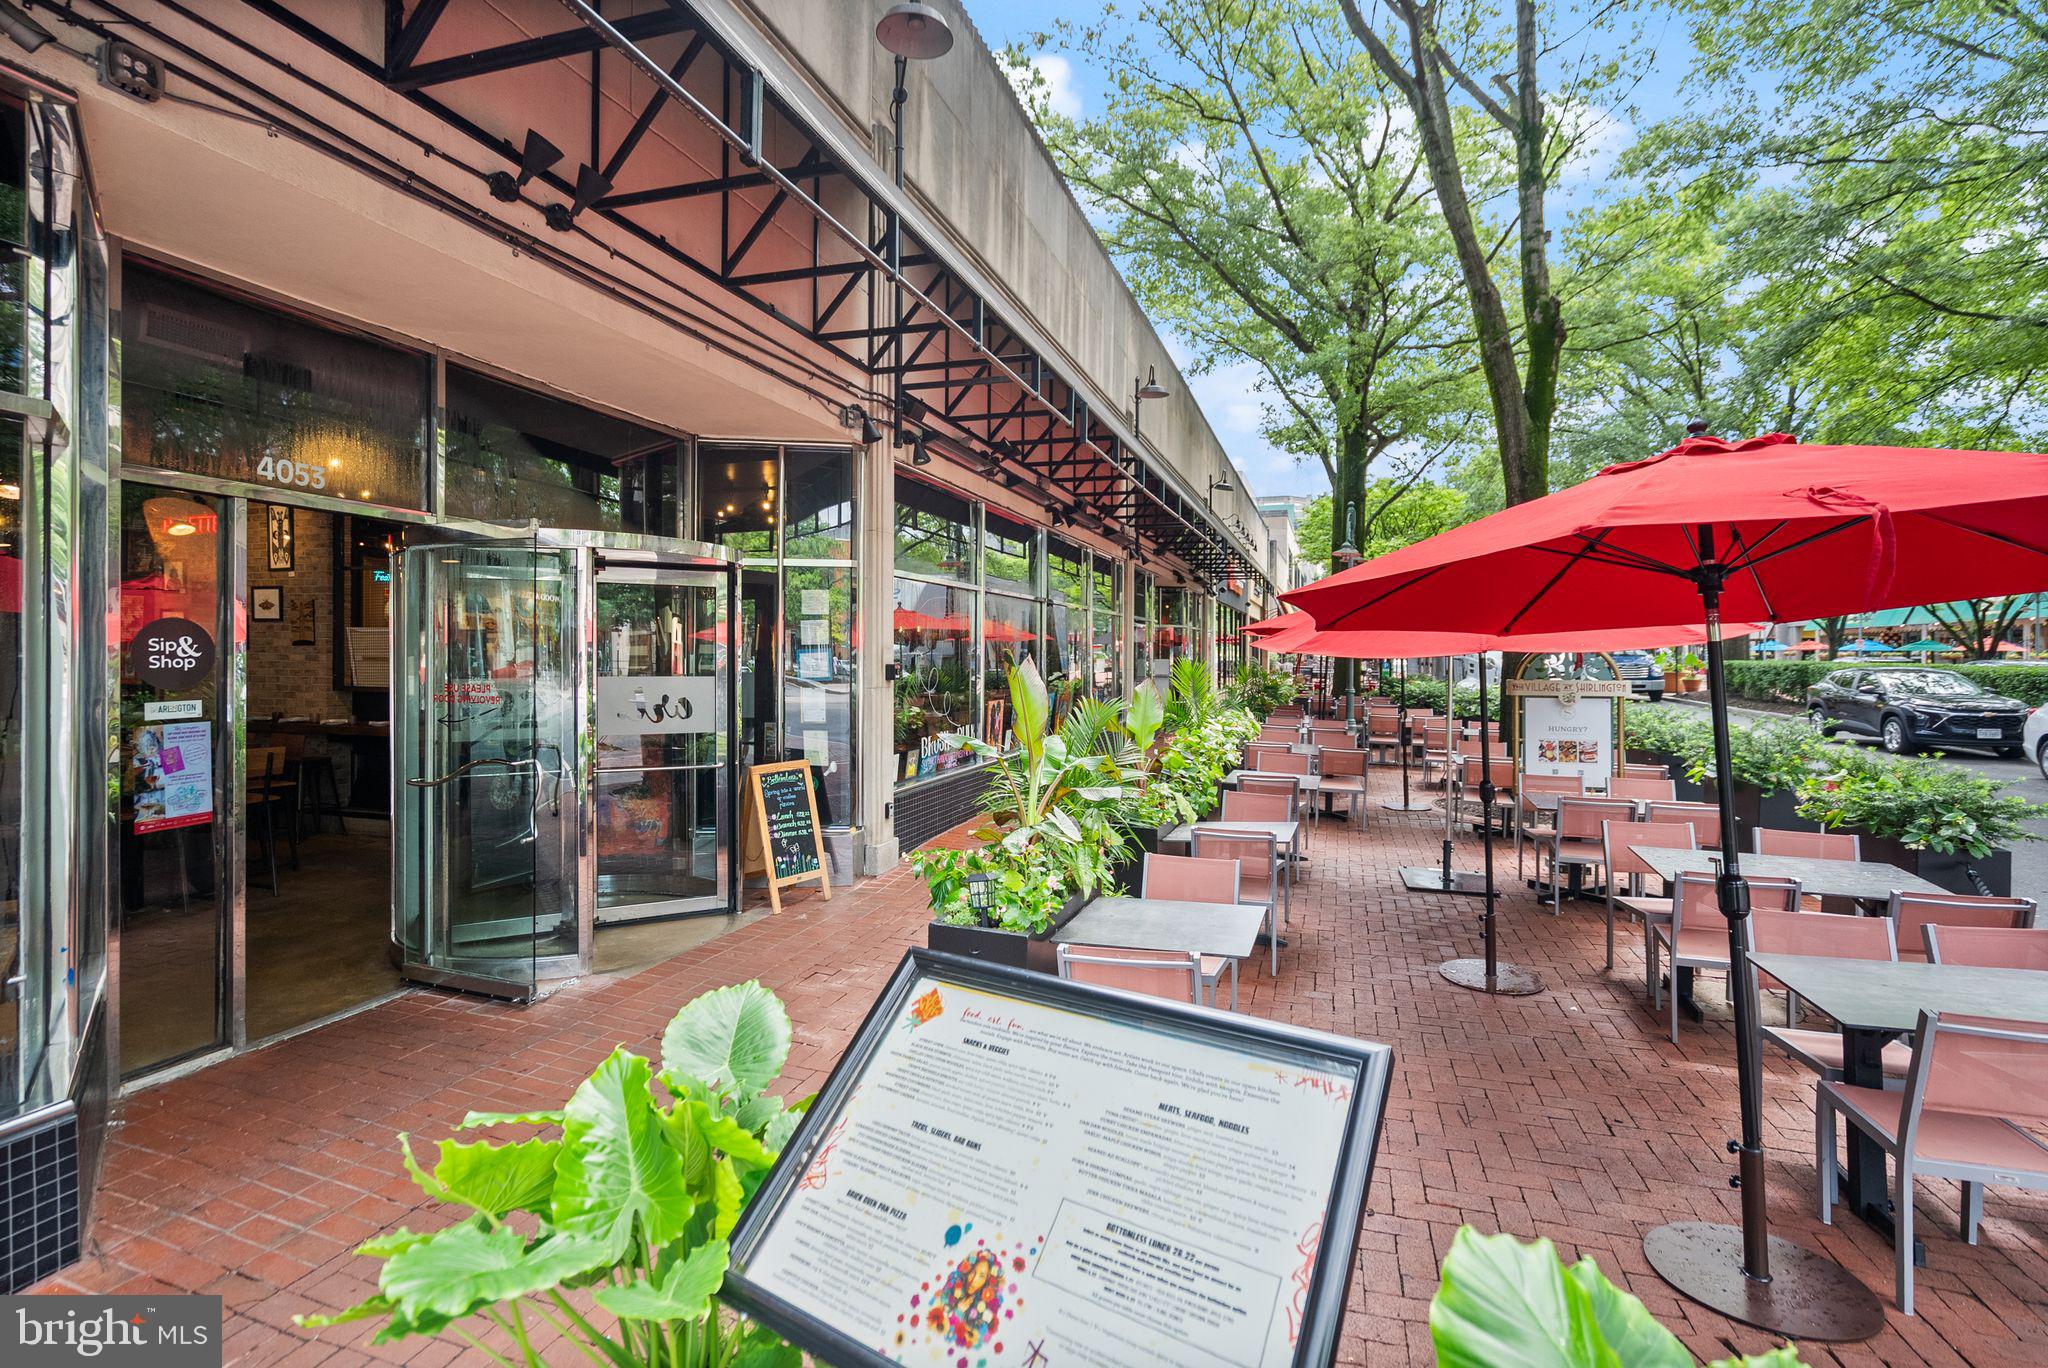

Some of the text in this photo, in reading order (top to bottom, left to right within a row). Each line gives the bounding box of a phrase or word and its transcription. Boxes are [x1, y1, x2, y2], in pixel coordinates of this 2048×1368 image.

[257, 456, 326, 490] 4053
[148, 655, 196, 671] Shop
[1524, 683, 1560, 692] VILLAGE
[1575, 682, 1627, 693] SHIRLINGTON
[963, 1037, 983, 1049] SNACKS
[988, 1044, 1010, 1056] VEGGIES
[1158, 1102, 1250, 1135] MEATS, SEAFOOD, NOODLES
[930, 1126, 952, 1143] SLIDERS,
[862, 1194, 878, 1209] OVEN
[878, 1200, 891, 1214] PAN
[890, 1206, 908, 1222] PIZZA
[1106, 1222, 1147, 1244] BOTTOMLESS
[1148, 1238, 1171, 1253] LUNCH
